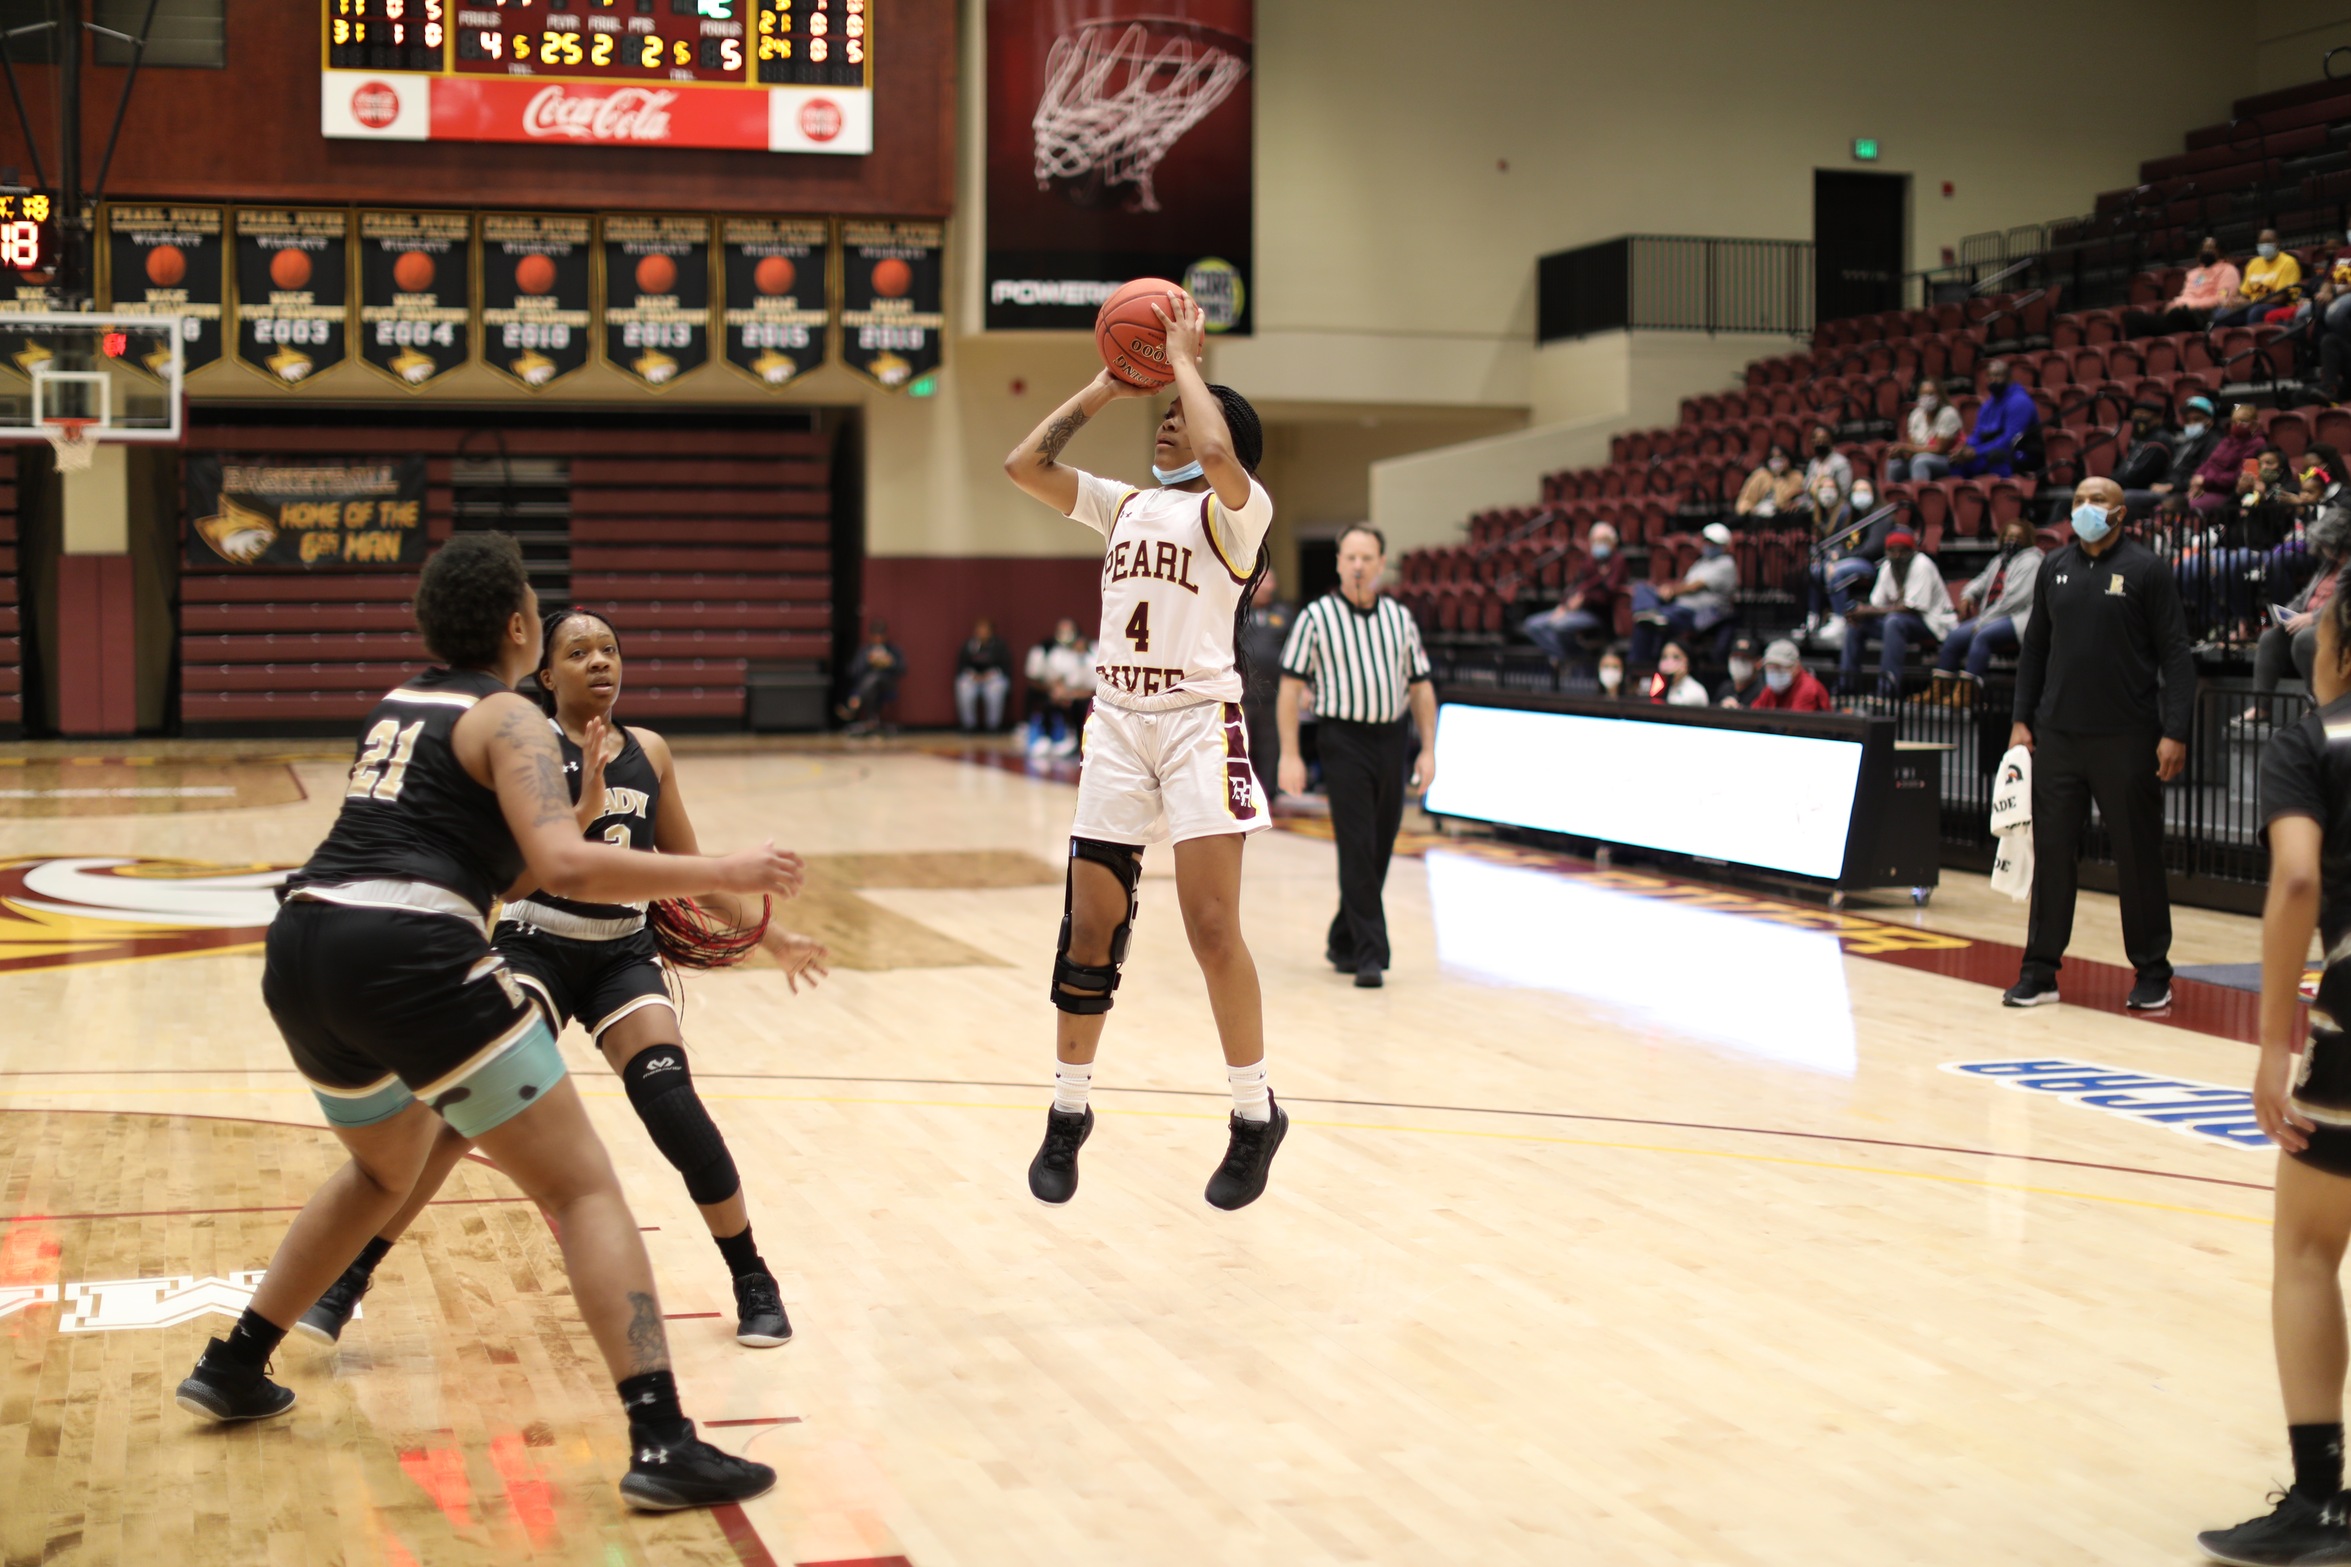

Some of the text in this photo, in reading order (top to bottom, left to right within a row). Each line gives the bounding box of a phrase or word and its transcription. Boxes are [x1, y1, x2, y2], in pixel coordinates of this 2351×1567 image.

[480, 31, 502, 60] 4
[541, 31, 583, 65] 25
[591, 33, 613, 66] 2
[642, 35, 663, 68] 2
[721, 38, 742, 71] 5
[254, 319, 330, 345] 2003
[375, 321, 454, 347] 2004
[279, 500, 420, 529] HOME OF THE
[344, 530, 402, 563] MAN
[1125, 601, 1150, 653] 4
[347, 719, 426, 802] 21
[595, 786, 650, 819] ADY
